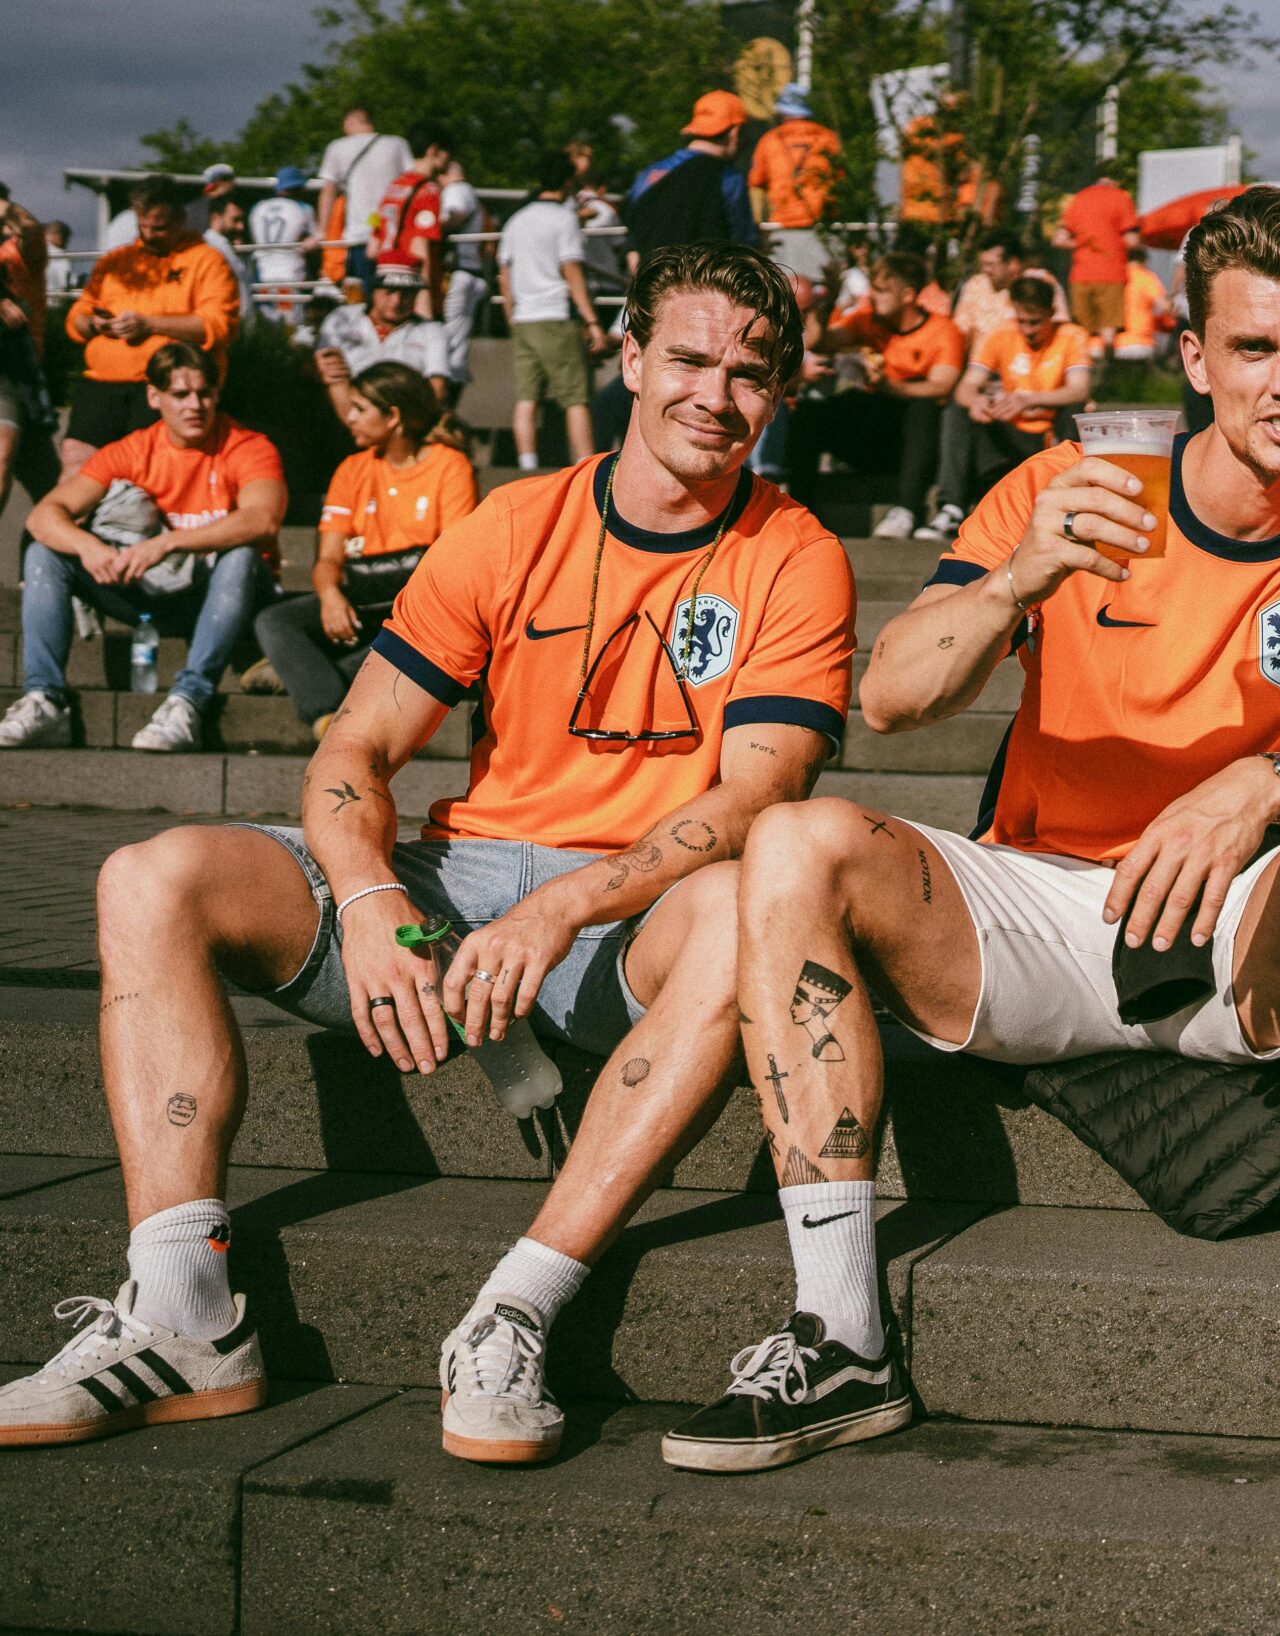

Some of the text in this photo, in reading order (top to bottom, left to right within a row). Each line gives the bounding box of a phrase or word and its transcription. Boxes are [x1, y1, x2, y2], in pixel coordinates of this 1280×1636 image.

[697, 599, 719, 608] KNVB
[918, 847, 932, 905] MOTION
[499, 1308, 532, 1328] adidas
